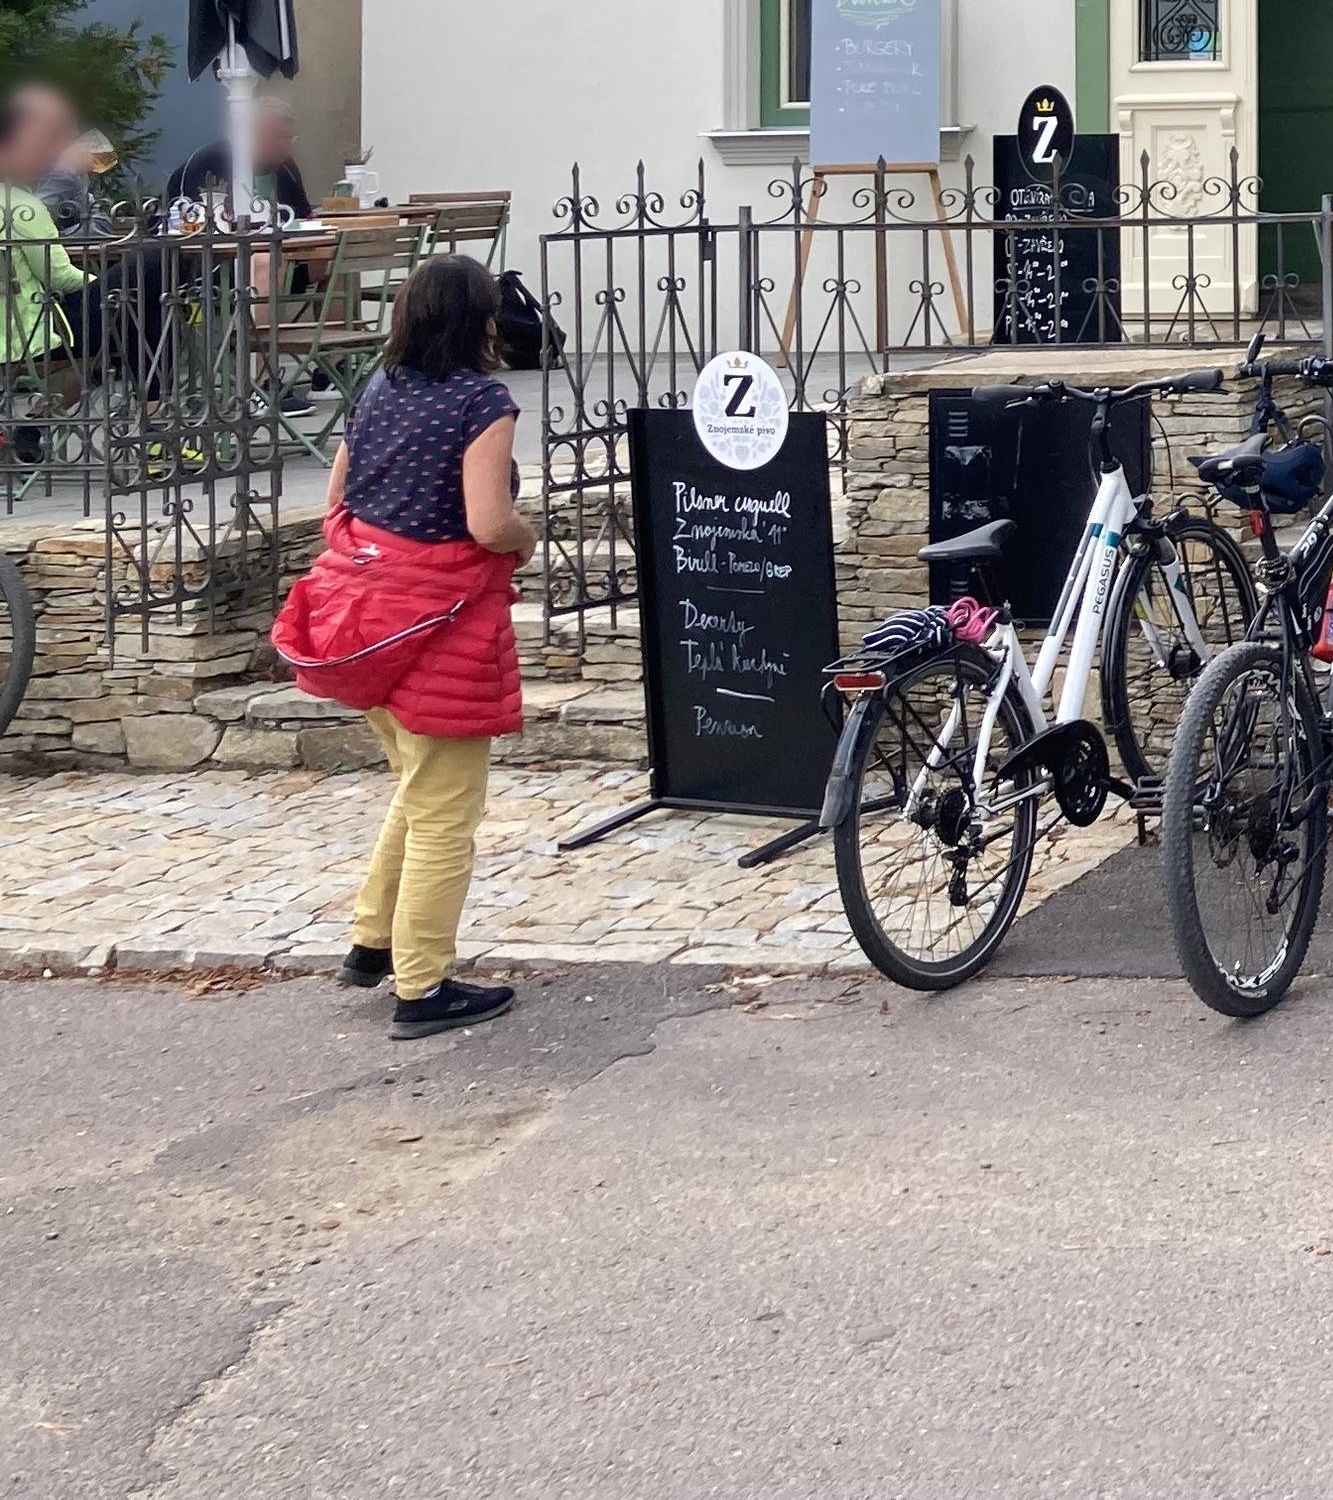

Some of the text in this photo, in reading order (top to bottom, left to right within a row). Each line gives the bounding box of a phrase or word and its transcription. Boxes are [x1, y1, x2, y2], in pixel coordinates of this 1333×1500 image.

[1032, 116, 1058, 163] Z
[723, 374, 756, 418] Z
[707, 424, 775, 436] Znojemské pivo
[1092, 548, 1114, 615] PEGASUS
